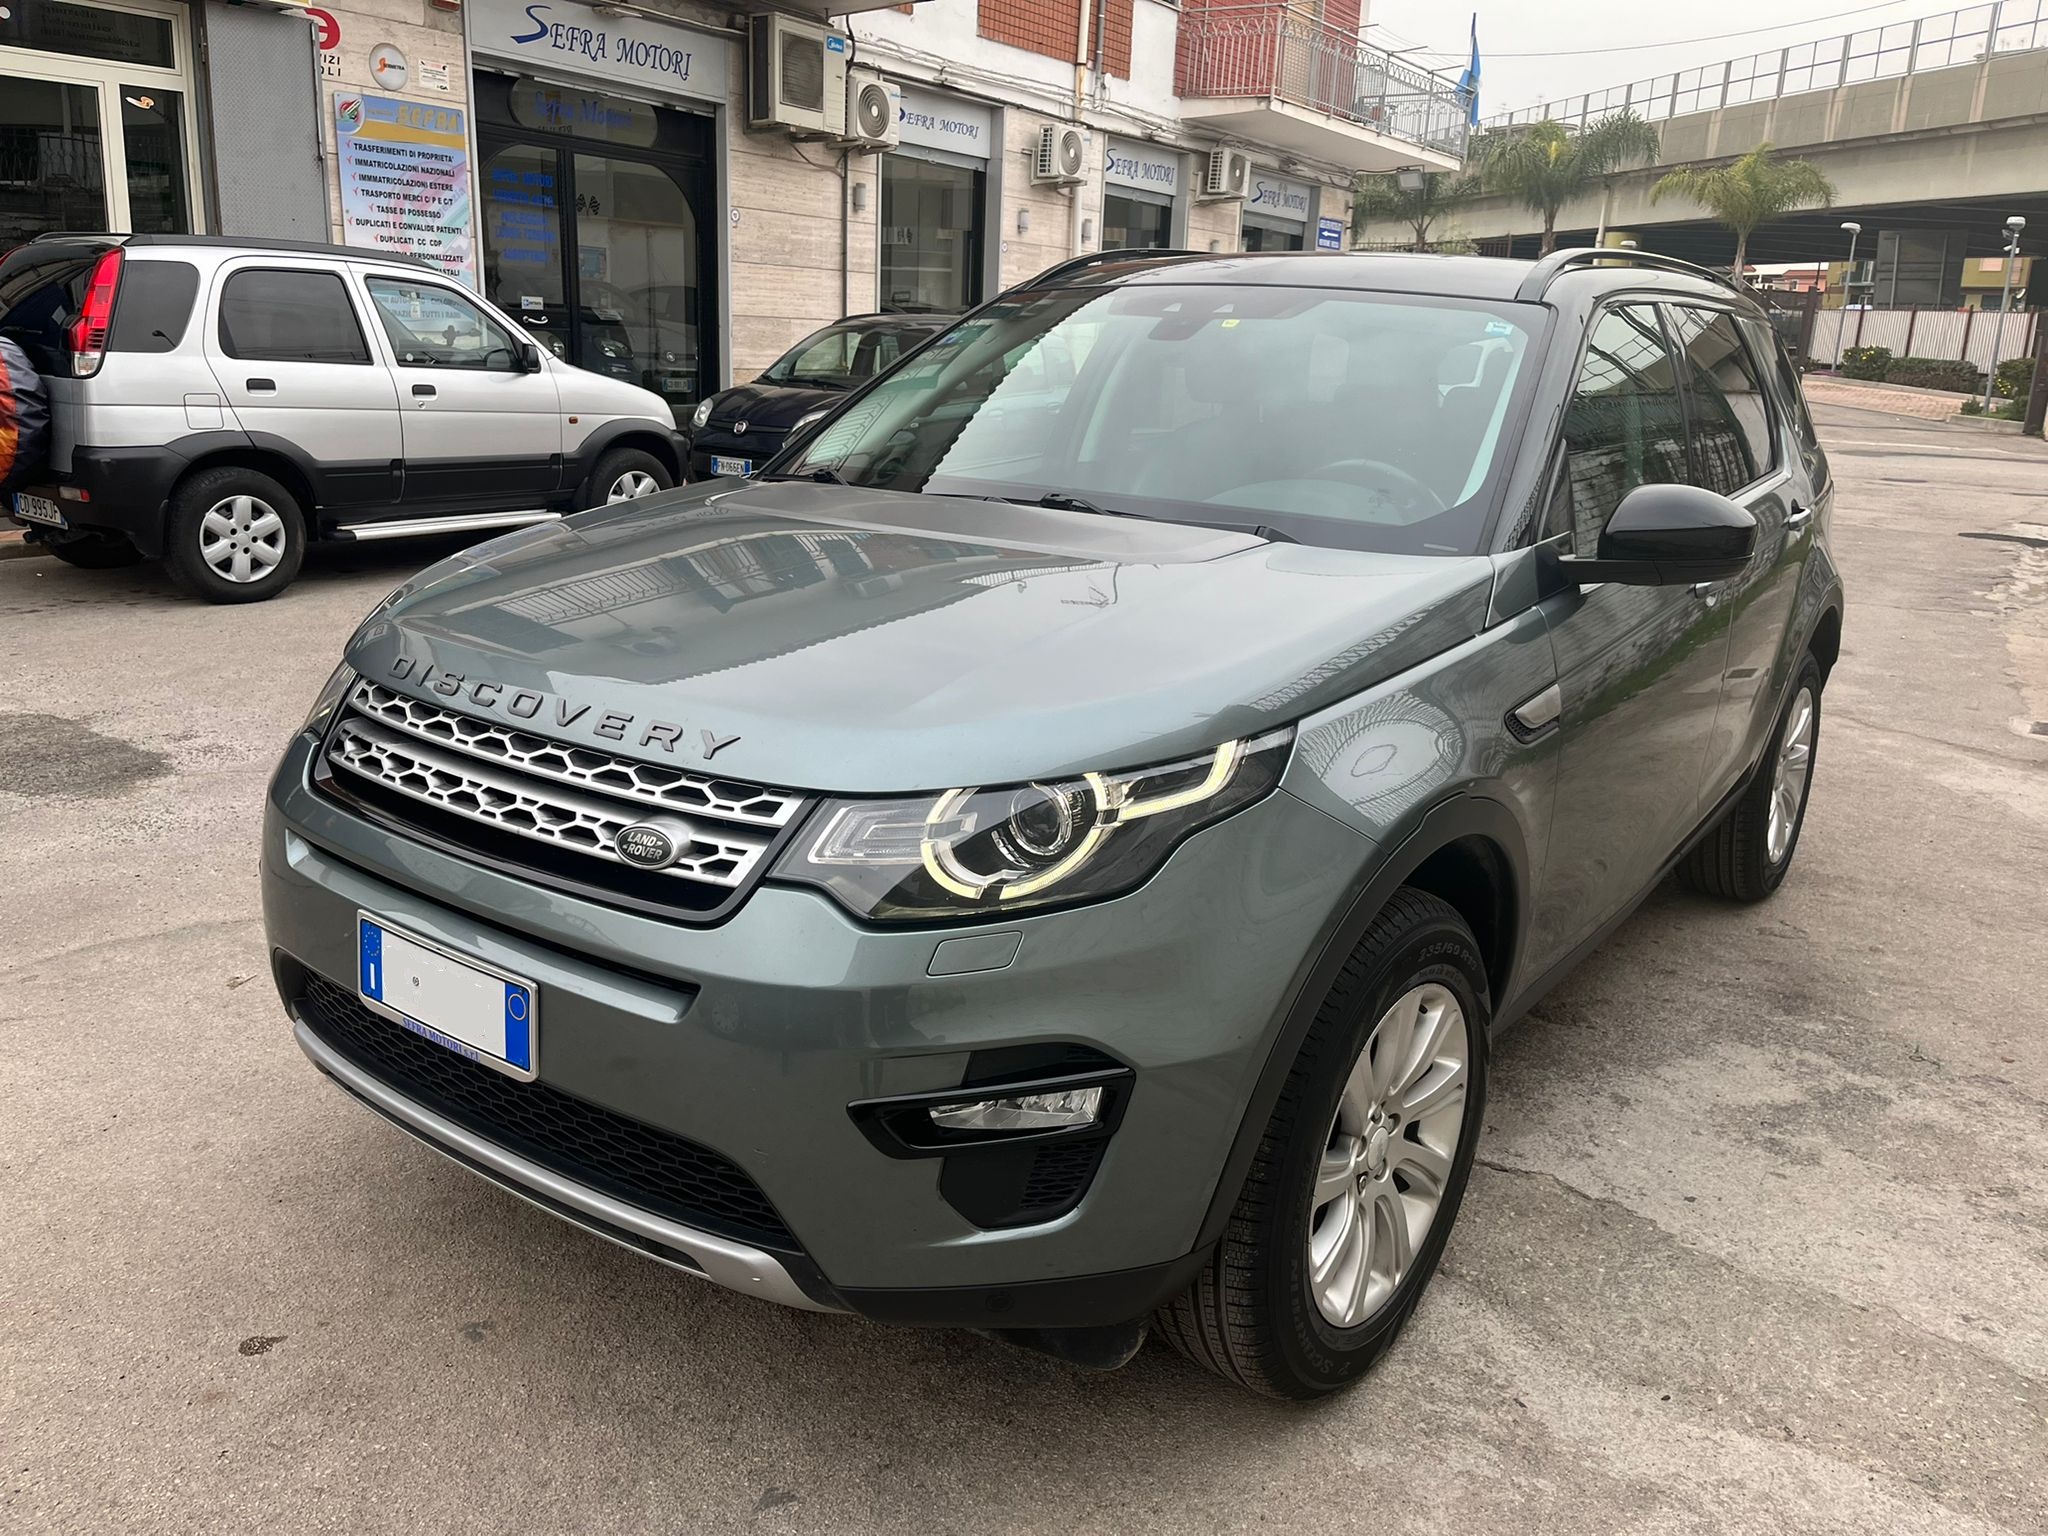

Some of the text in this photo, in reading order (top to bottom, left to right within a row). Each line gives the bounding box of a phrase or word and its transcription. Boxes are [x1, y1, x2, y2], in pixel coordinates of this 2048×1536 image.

[510, 5, 692, 81] SEFRA MOTORI
[396, 105, 459, 131] SEFRA
[939, 120, 979, 140] MOTORI
[354, 143, 408, 157] TRASFERIMENTI
[409, 150, 416, 158] DI
[355, 158, 455, 178] IMMATRICOLAZIONI NAZIONALI
[1105, 148, 1175, 186] SEFRA MOTORI
[360, 188, 401, 200] TRASPORTO
[402, 193, 424, 203] MERCI
[429, 182, 453, 192] ESTERE
[377, 205, 398, 215] TASSE
[408, 209, 442, 219] POSSESSO
[356, 218, 391, 229] DUPLICATI
[399, 222, 434, 233] CONVALIDE
[436, 225, 463, 235] PATENTI
[380, 235, 415, 245] DUPLICATI
[387, 654, 742, 761] DISCOVERY
[627, 831, 657, 847] LAND
[626, 843, 663, 860] ROVER
[402, 1016, 428, 1038] SEFRA
[428, 1029, 462, 1053] MOTORI
